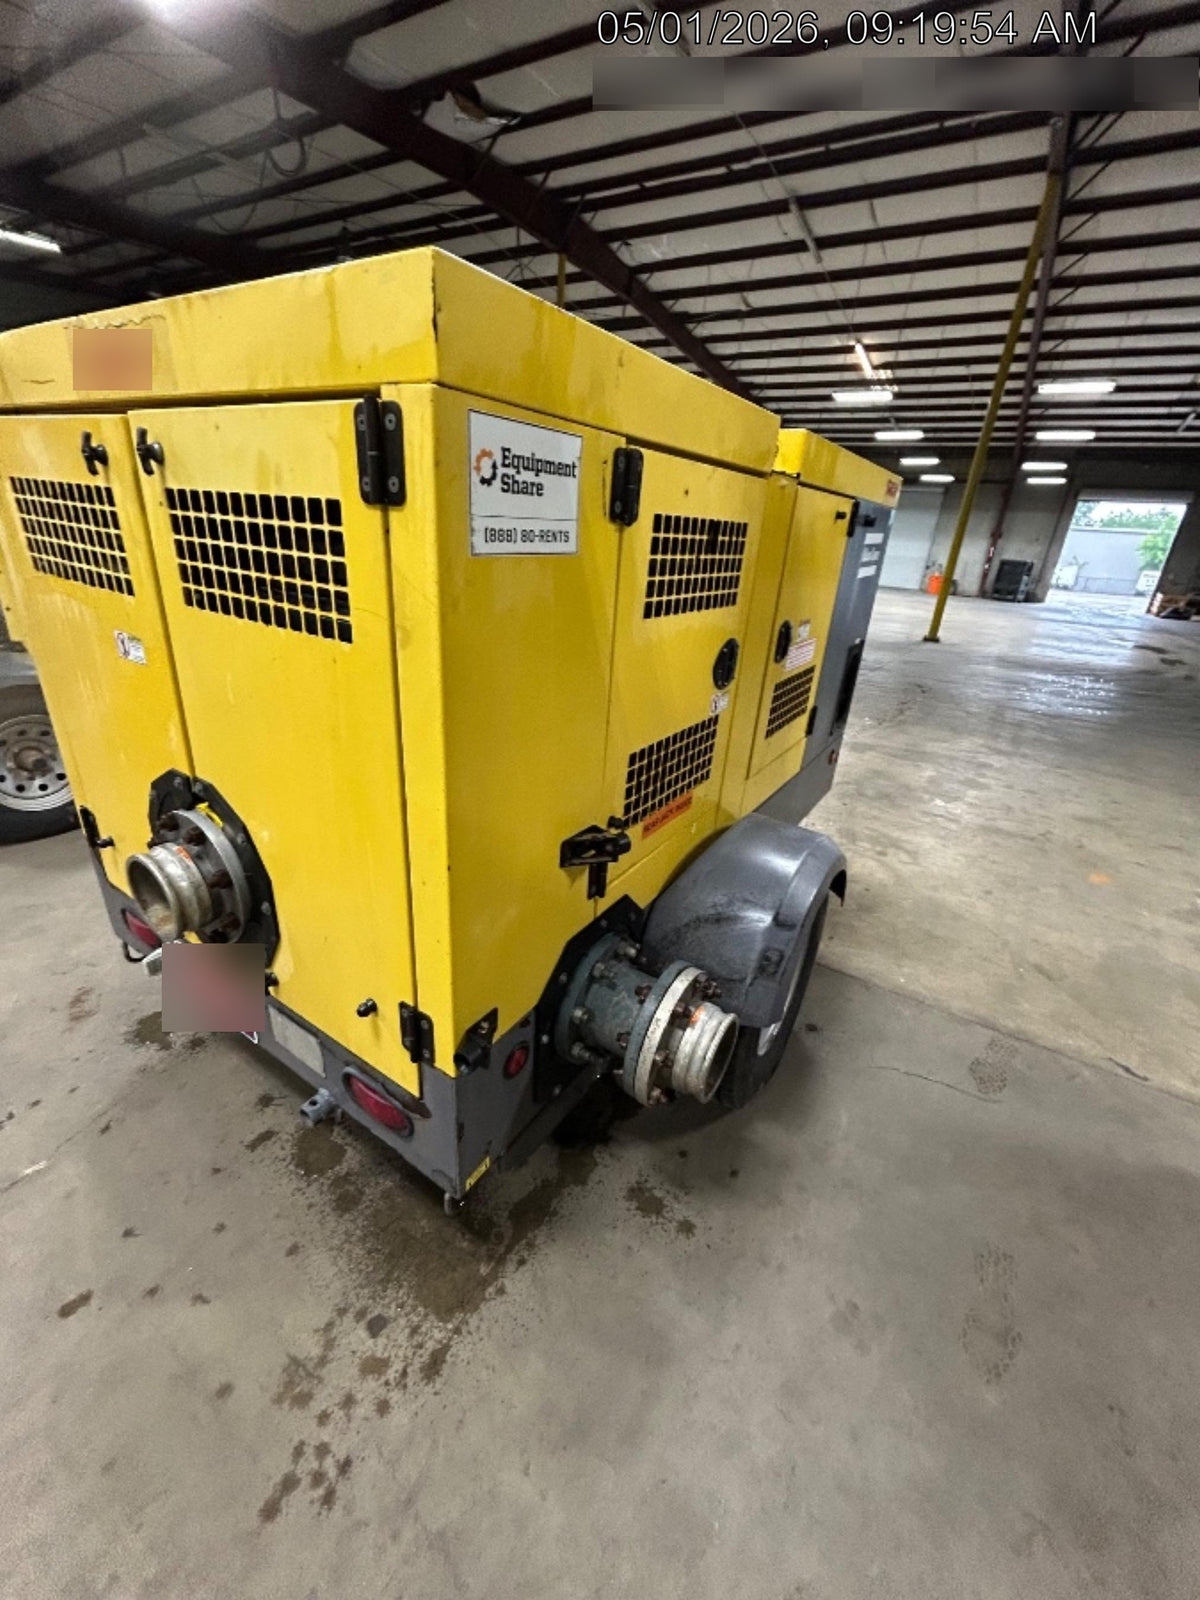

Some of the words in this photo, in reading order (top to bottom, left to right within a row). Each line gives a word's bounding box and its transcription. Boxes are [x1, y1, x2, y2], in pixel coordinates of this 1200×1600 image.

[500, 446, 577, 478] Equipment
[500, 473, 544, 497] Share
[520, 529, 570, 544] 80-RENTS
